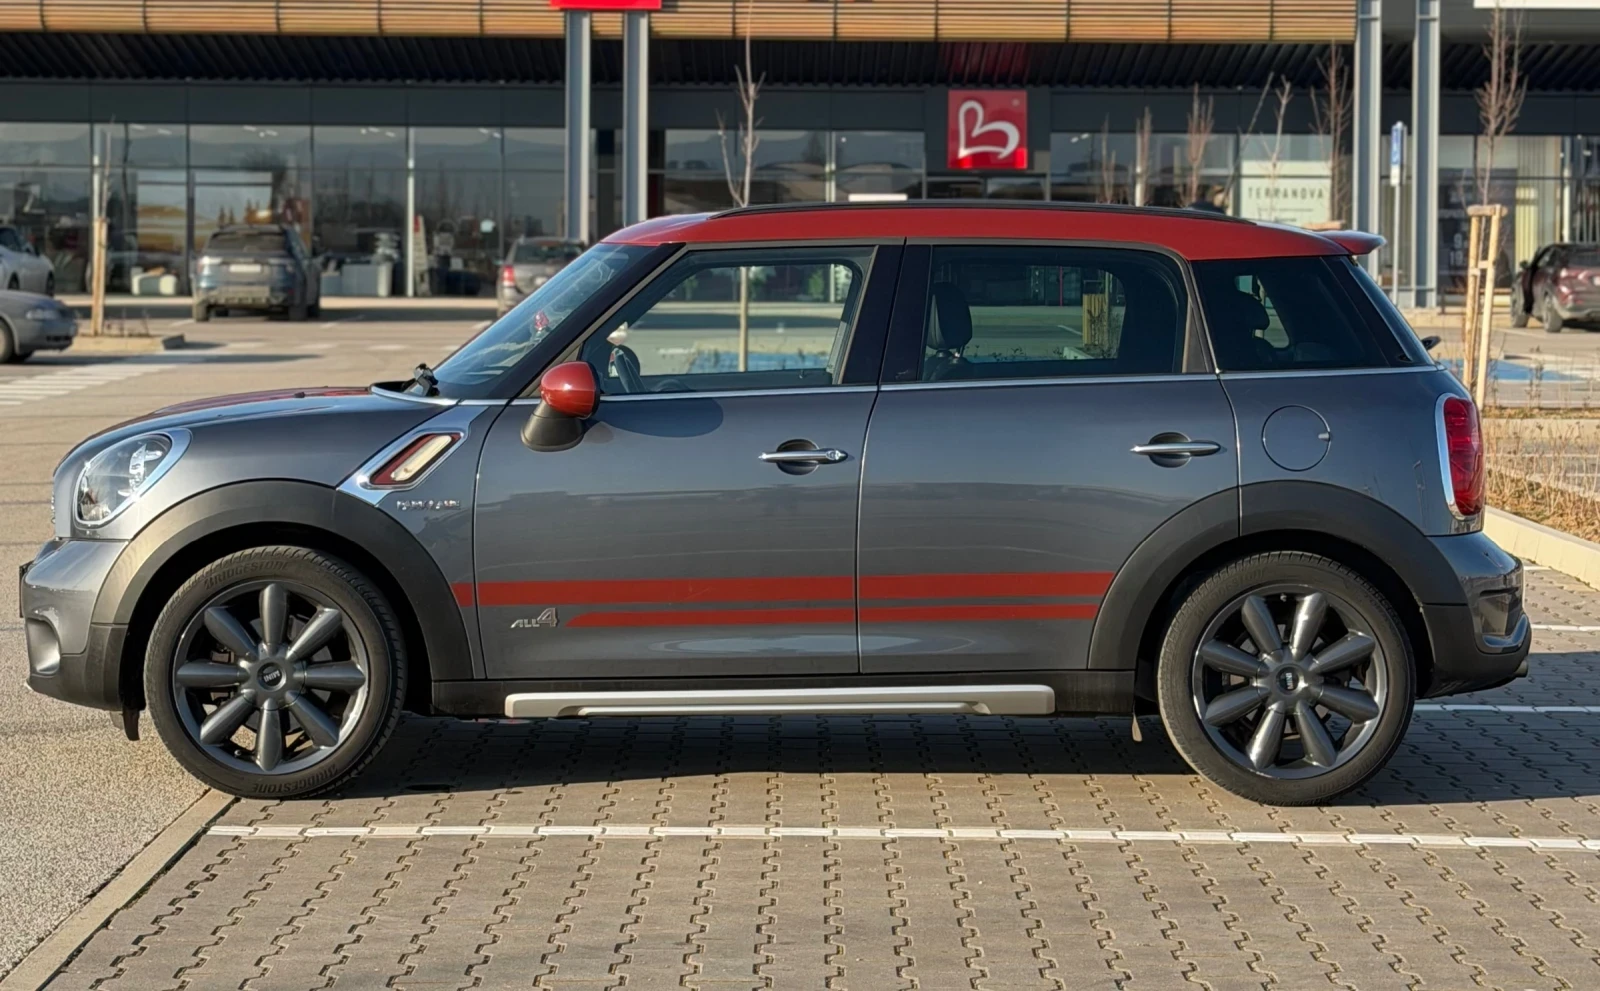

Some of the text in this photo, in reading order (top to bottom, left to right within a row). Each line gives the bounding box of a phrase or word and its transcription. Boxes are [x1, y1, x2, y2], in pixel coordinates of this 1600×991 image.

[1248, 187, 1324, 199] TERRANOVA
[203, 560, 290, 590] BRIDGESTONE
[510, 607, 558, 628] ALL4
[251, 763, 340, 794] BRIDGESTONE
